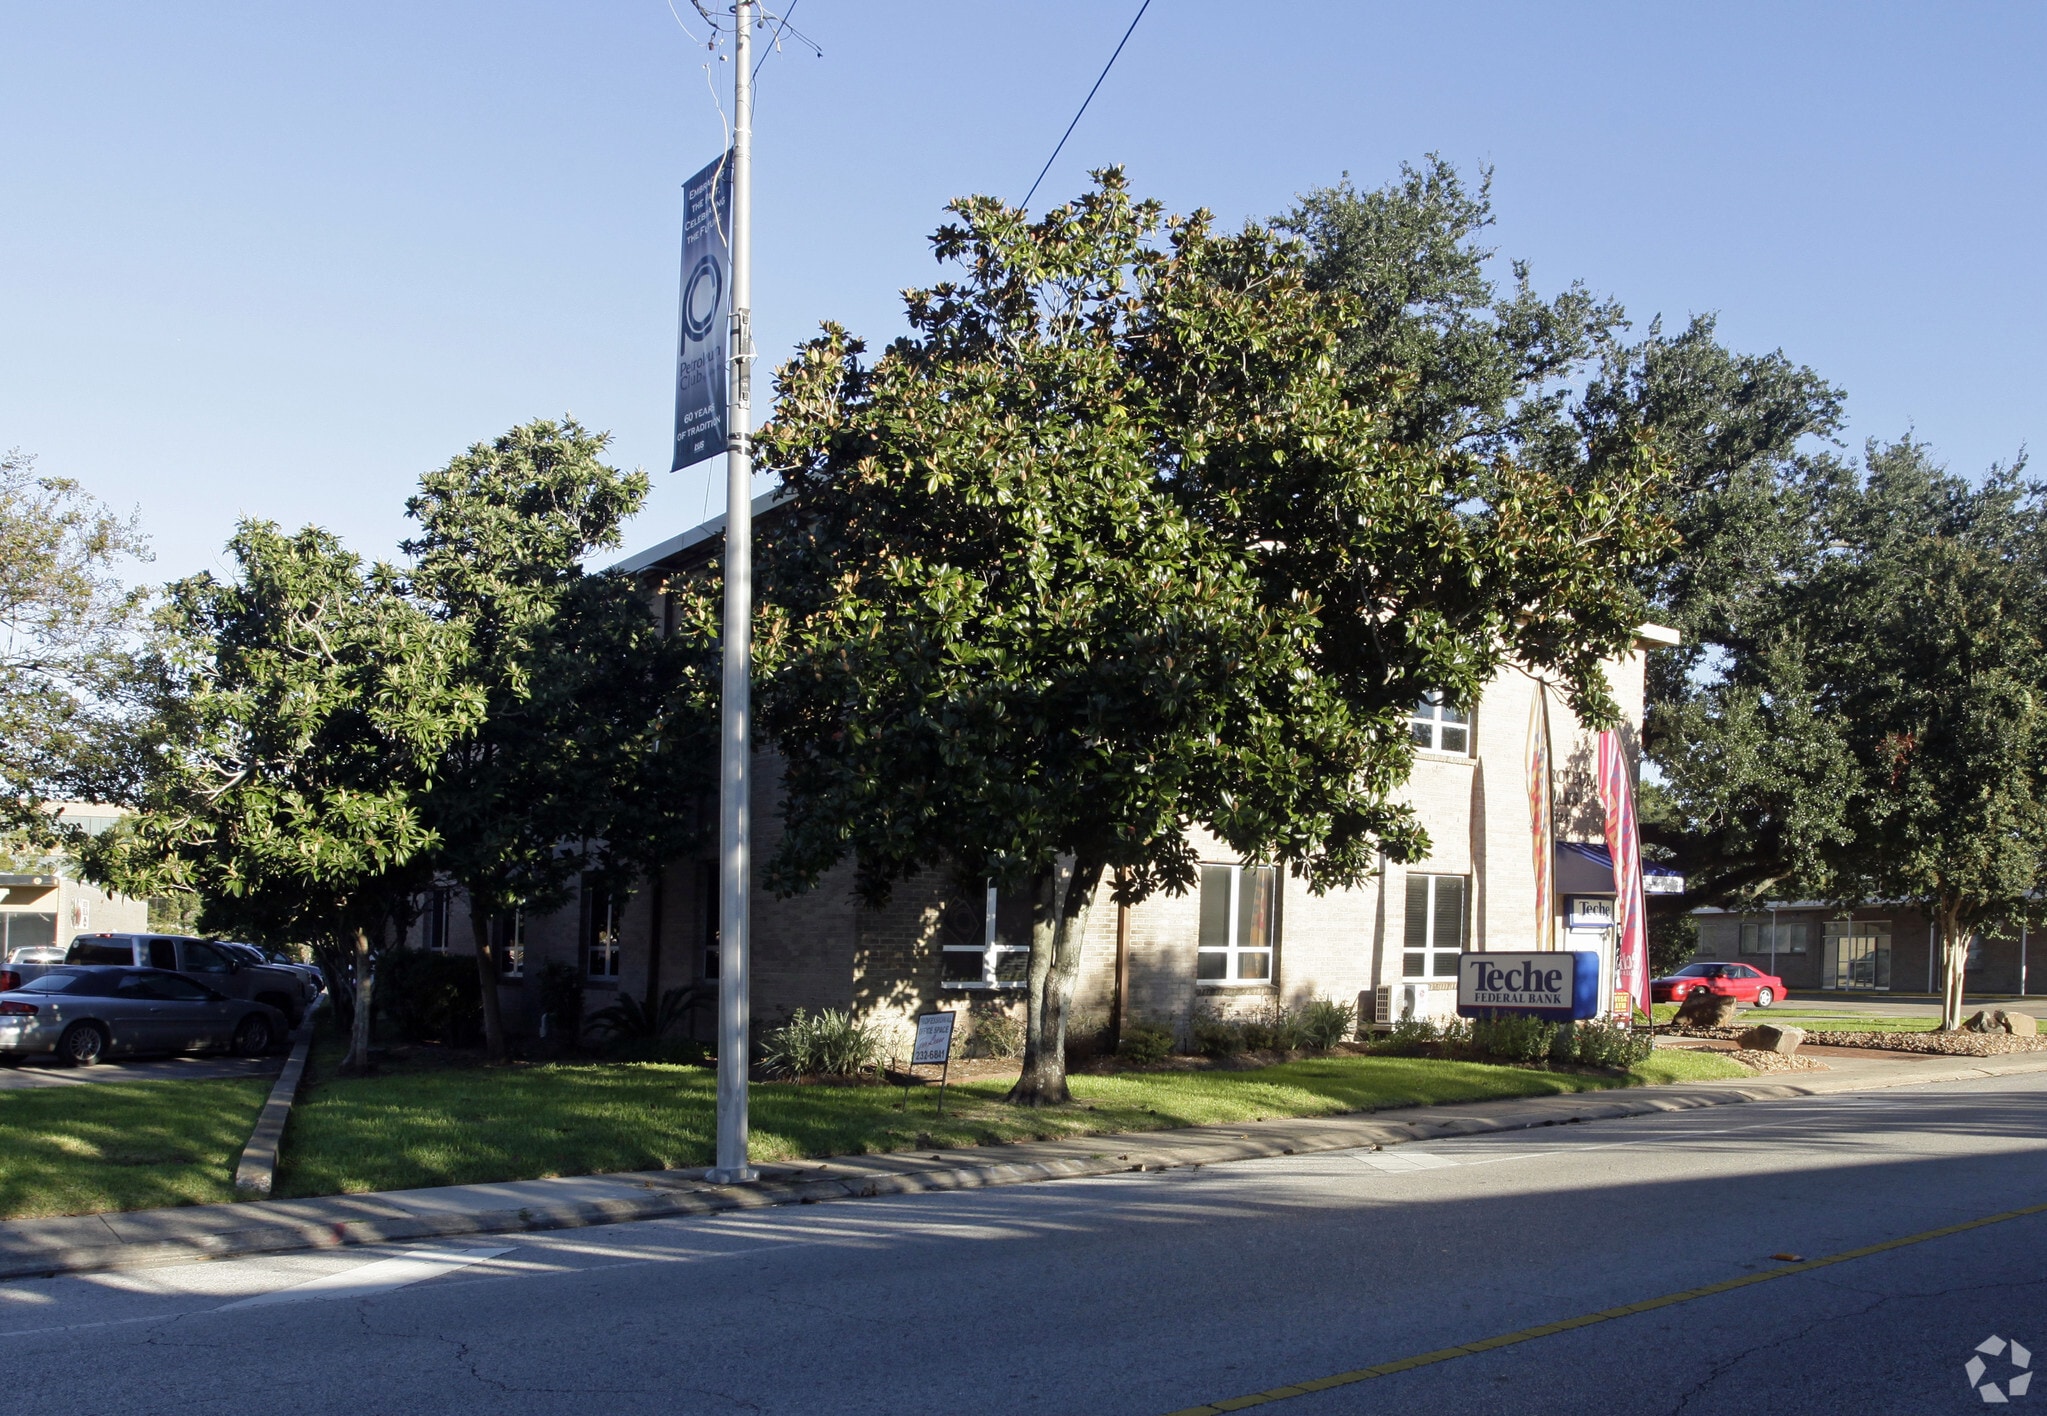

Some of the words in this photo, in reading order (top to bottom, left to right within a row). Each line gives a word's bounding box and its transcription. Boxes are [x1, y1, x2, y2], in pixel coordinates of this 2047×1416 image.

[684, 197, 726, 231] CELEBRANG
[680, 370, 703, 391] Club
[1579, 901, 1611, 917] Teche
[1470, 960, 1562, 993] Teche
[1475, 992, 1526, 1003] FEDERAL
[1528, 993, 1562, 1004] BANK
